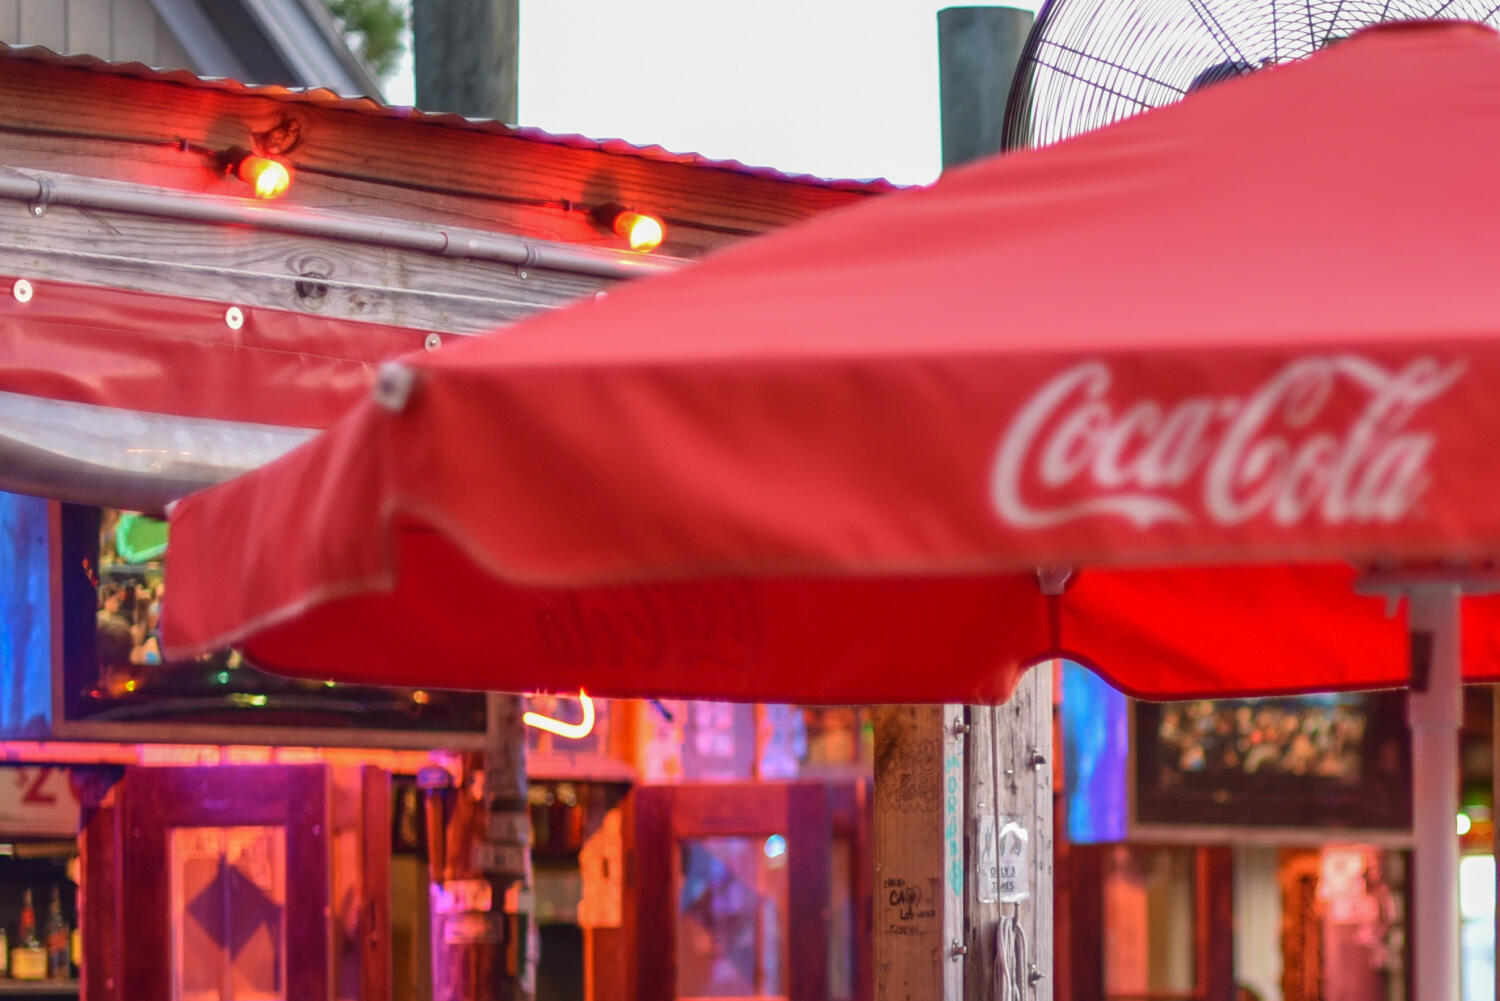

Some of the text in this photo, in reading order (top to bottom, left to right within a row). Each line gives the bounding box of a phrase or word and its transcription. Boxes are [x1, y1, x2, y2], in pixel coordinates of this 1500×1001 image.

[990, 360, 1467, 531] Coca-Cola
[990, 866, 1009, 876] OLY
[991, 881, 1015, 890] TMES
